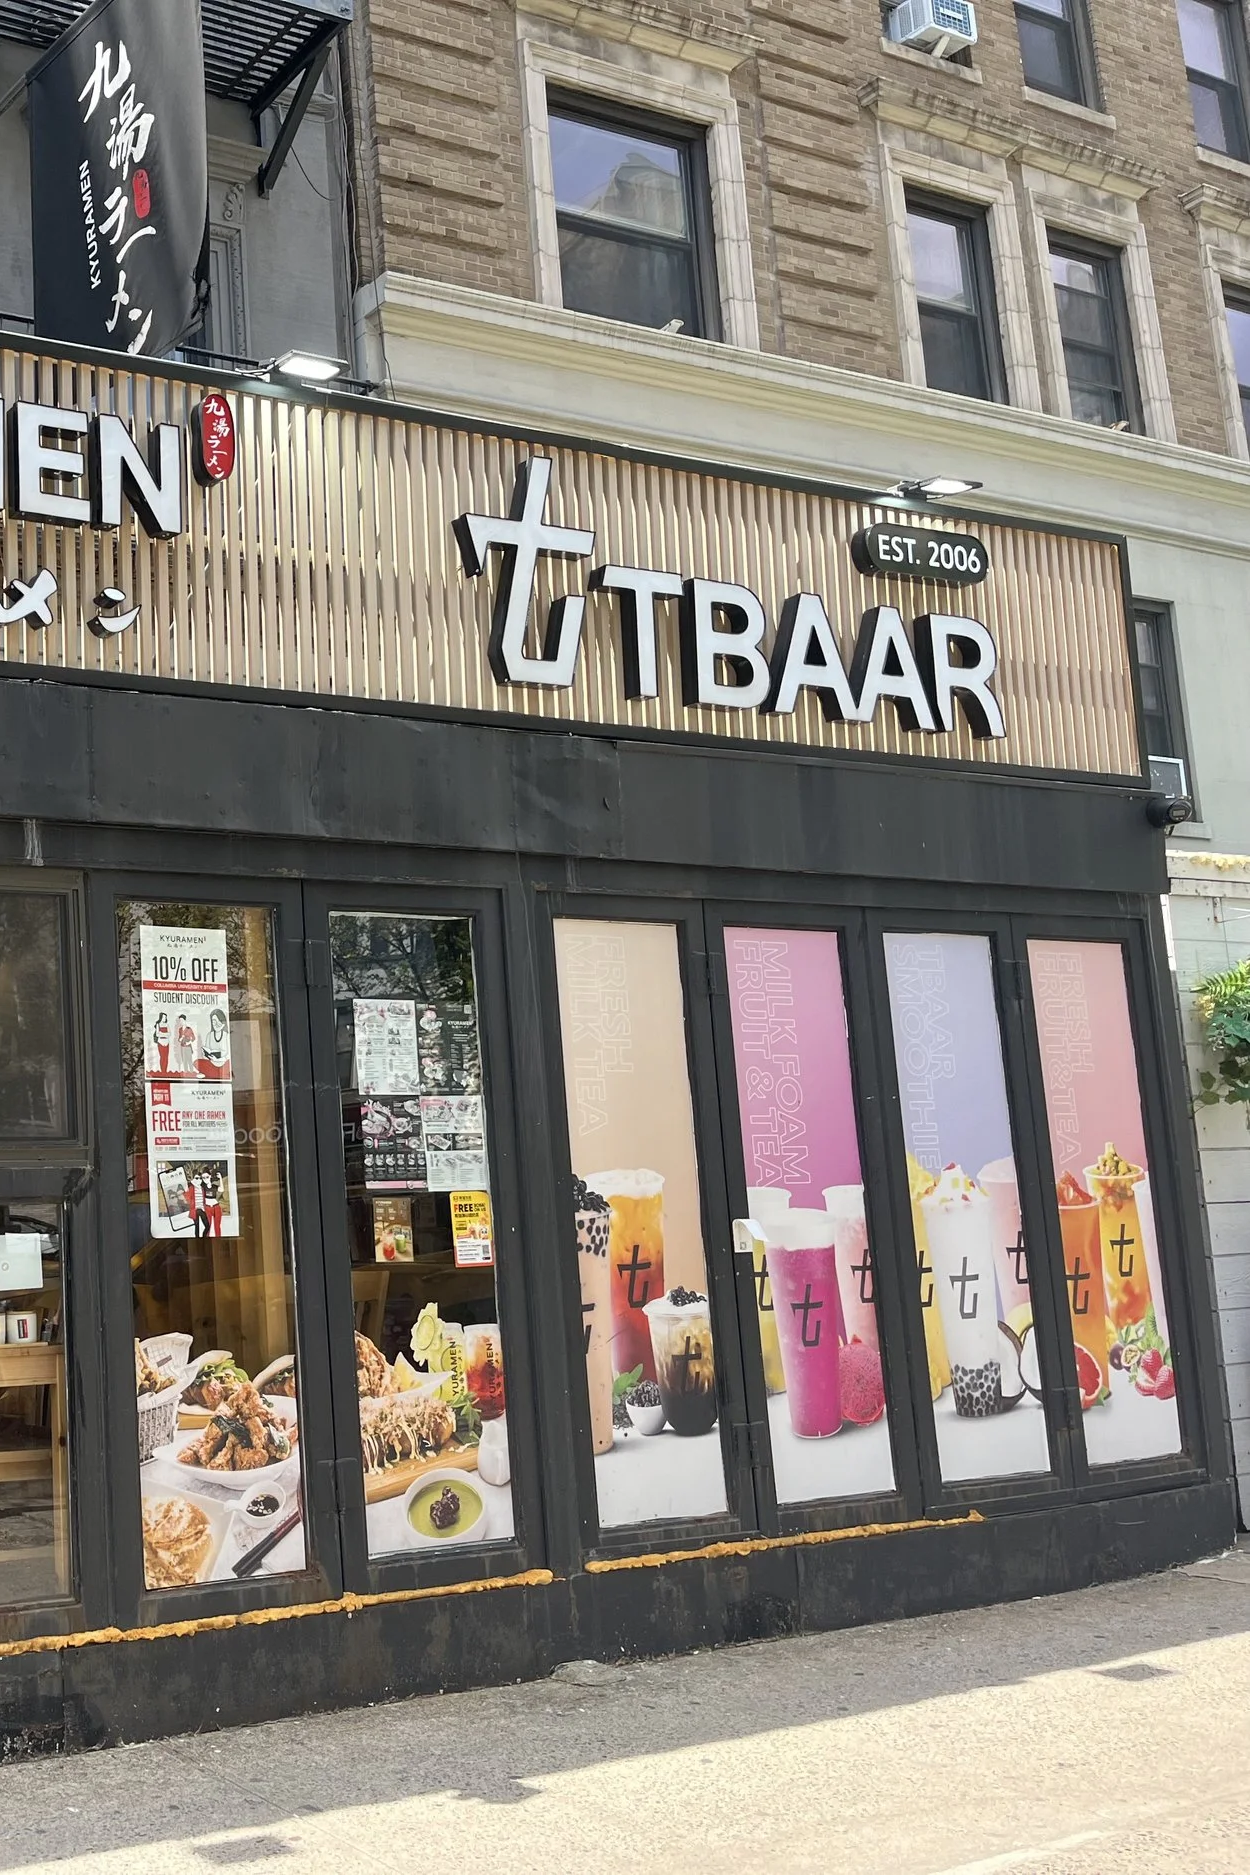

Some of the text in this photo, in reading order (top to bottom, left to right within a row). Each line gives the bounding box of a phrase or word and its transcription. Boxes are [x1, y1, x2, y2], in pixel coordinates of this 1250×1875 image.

[78, 159, 102, 290] KYURAMEN
[205, 398, 230, 479] 九湯ラーメン
[878, 533, 982, 575] EST. 2006
[591, 564, 1006, 739] TBAAR
[152, 956, 219, 983] 10% OFF
[154, 992, 219, 1005] STUDENT DISCOUNT
[160, 935, 204, 944] KYURAMEN
[563, 933, 608, 1137] MILK TEA
[592, 935, 634, 1074] FRESH
[733, 939, 783, 1188] FRUIT & TEA
[761, 940, 812, 1184] MILK FOAM
[892, 944, 943, 1169] SMOOTHIE
[916, 944, 957, 1080] TBAAR
[1057, 952, 1095, 1073] FRESH
[152, 1110, 182, 1132] FREE
[453, 1203, 474, 1213] FREE
[449, 1341, 460, 1397] YURAMEN
